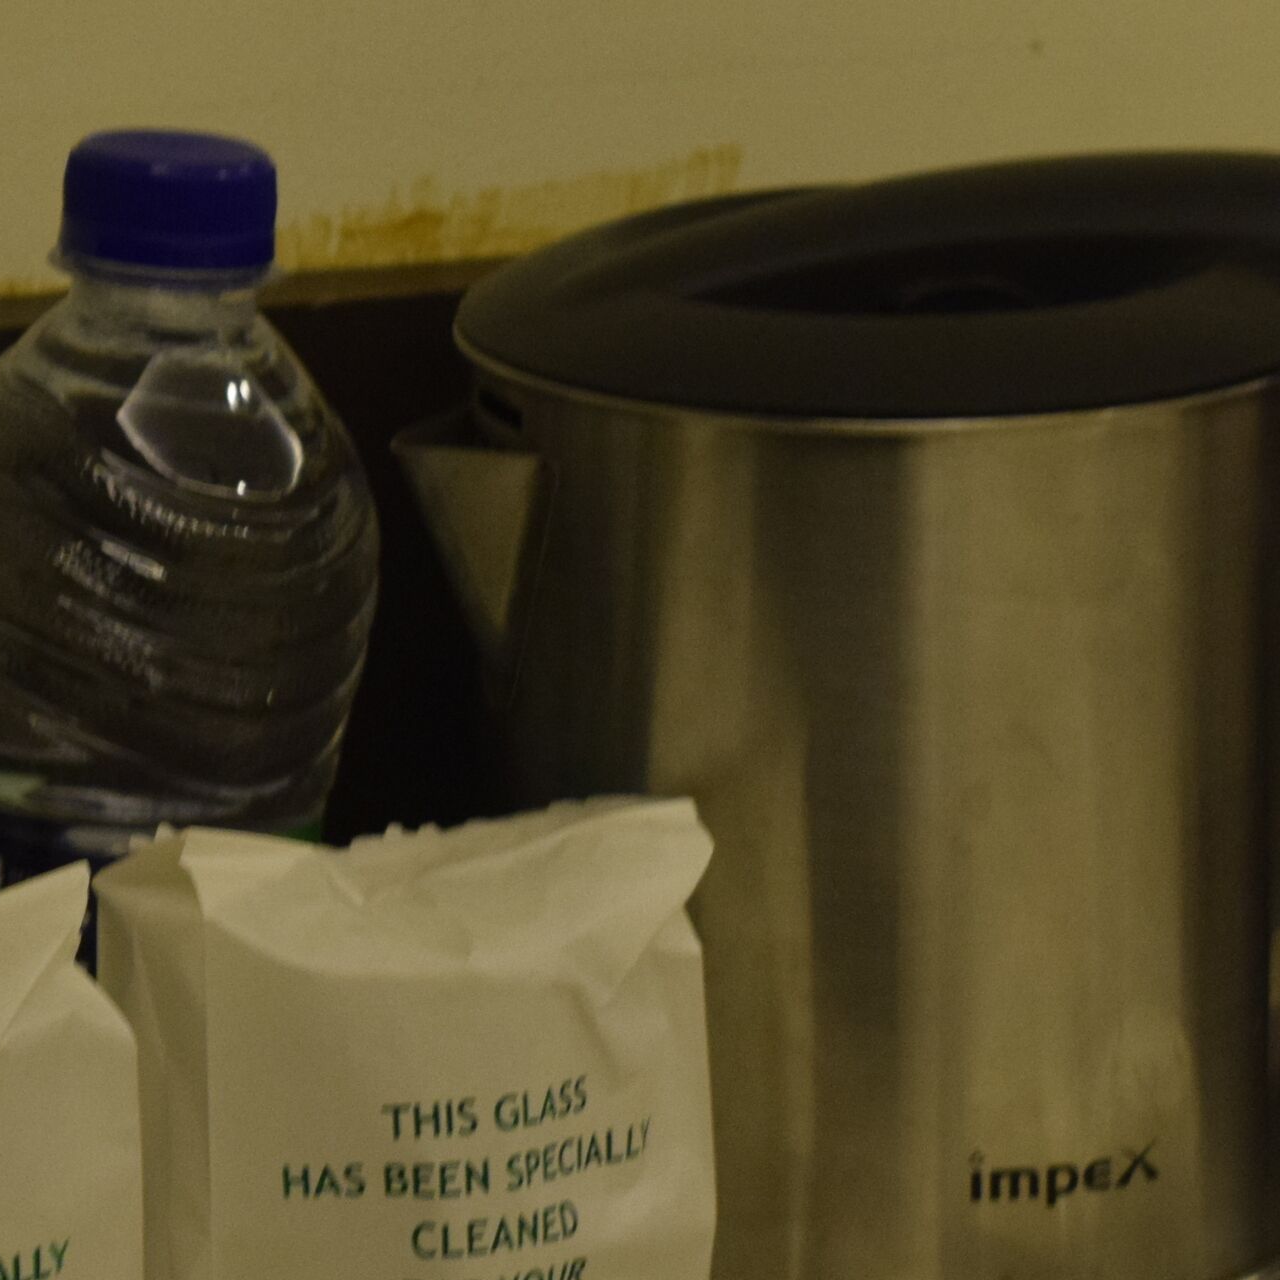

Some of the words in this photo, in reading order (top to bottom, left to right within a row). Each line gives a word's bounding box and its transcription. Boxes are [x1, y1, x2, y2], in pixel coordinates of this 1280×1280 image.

[382, 1096, 479, 1142] THIS
[493, 1074, 588, 1133] GLASS
[281, 1160, 366, 1201] HAS
[383, 1157, 491, 1200] BEEN
[505, 1116, 652, 1193] SPECIALLY
[411, 1199, 579, 1259] CLEANED
